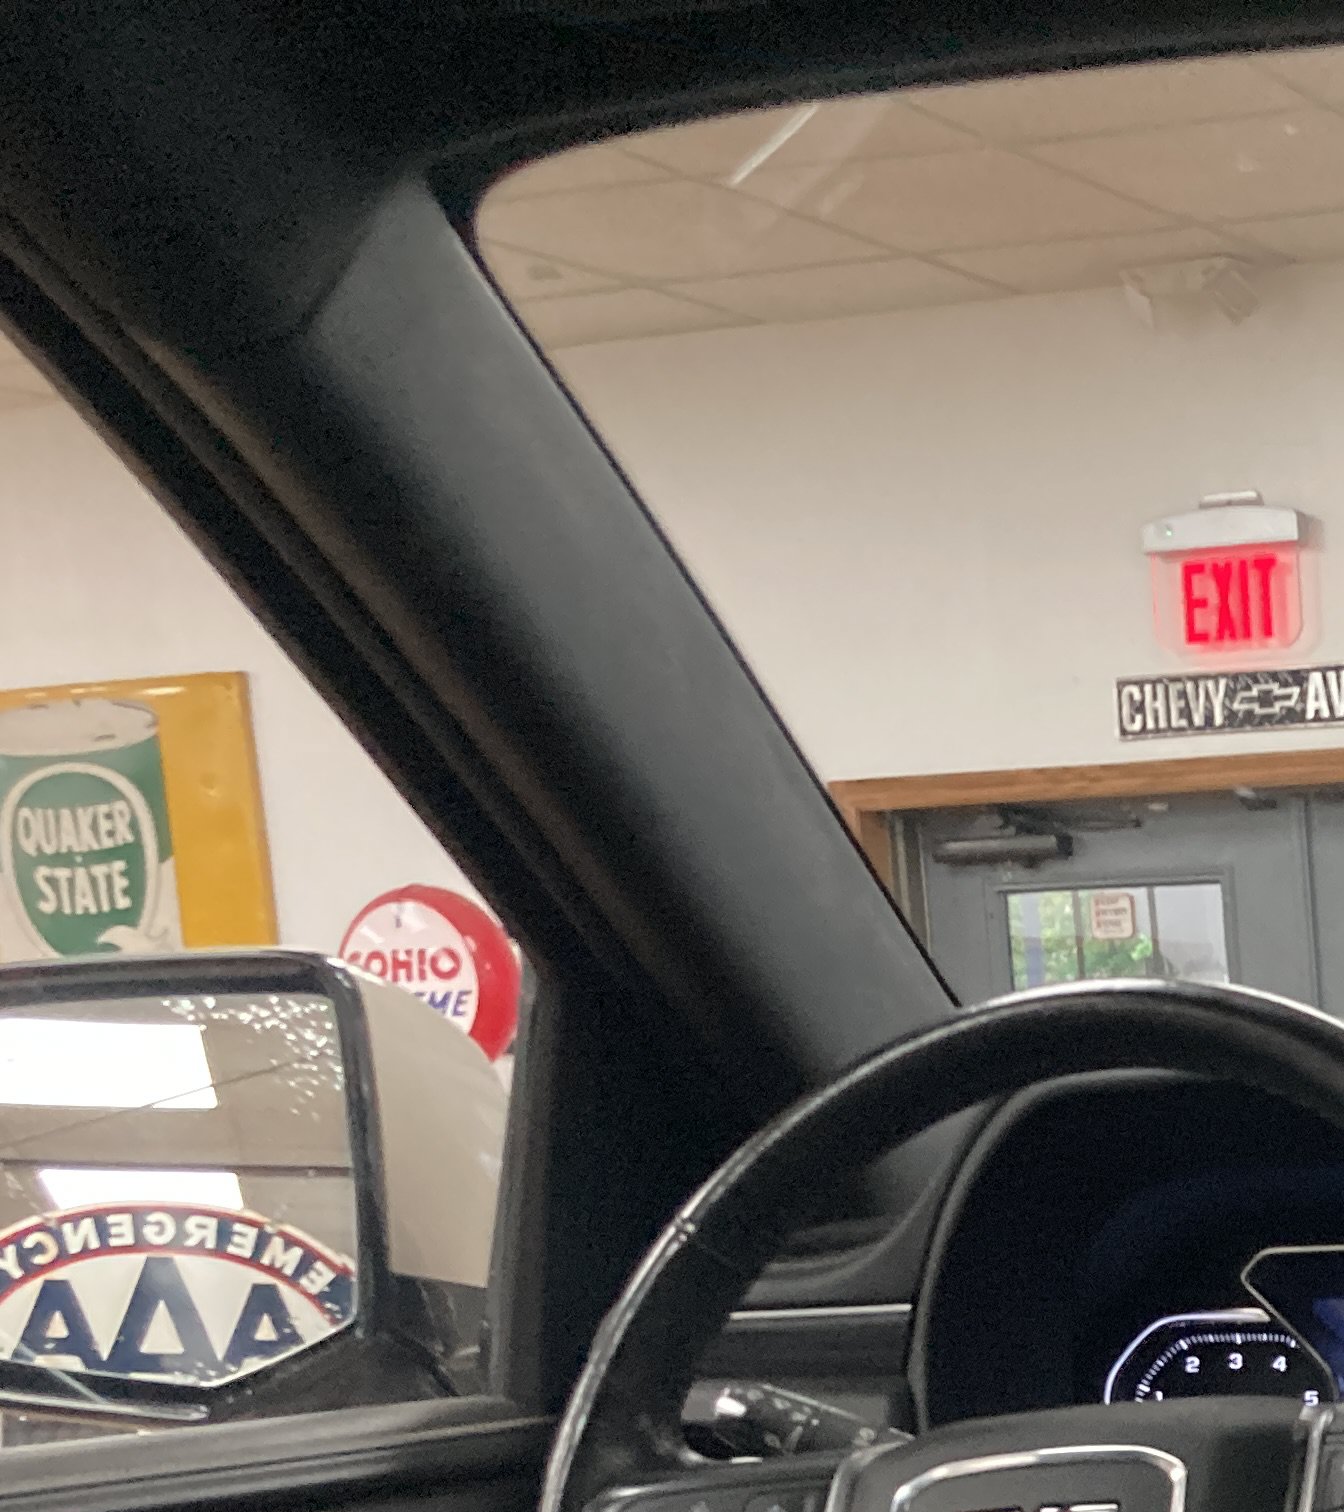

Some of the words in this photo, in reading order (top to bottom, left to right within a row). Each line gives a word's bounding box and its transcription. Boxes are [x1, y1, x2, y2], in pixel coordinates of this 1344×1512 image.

[1181, 554, 1277, 646] EXIT
[1121, 677, 1228, 733] CHEVY
[18, 800, 135, 856] QUAKER
[33, 859, 133, 915] STATE
[1184, 1355, 1200, 1373] 2
[1228, 1352, 1244, 1370] 3
[1272, 1355, 1288, 1372] 4
[1303, 1389, 1319, 1407] 5
